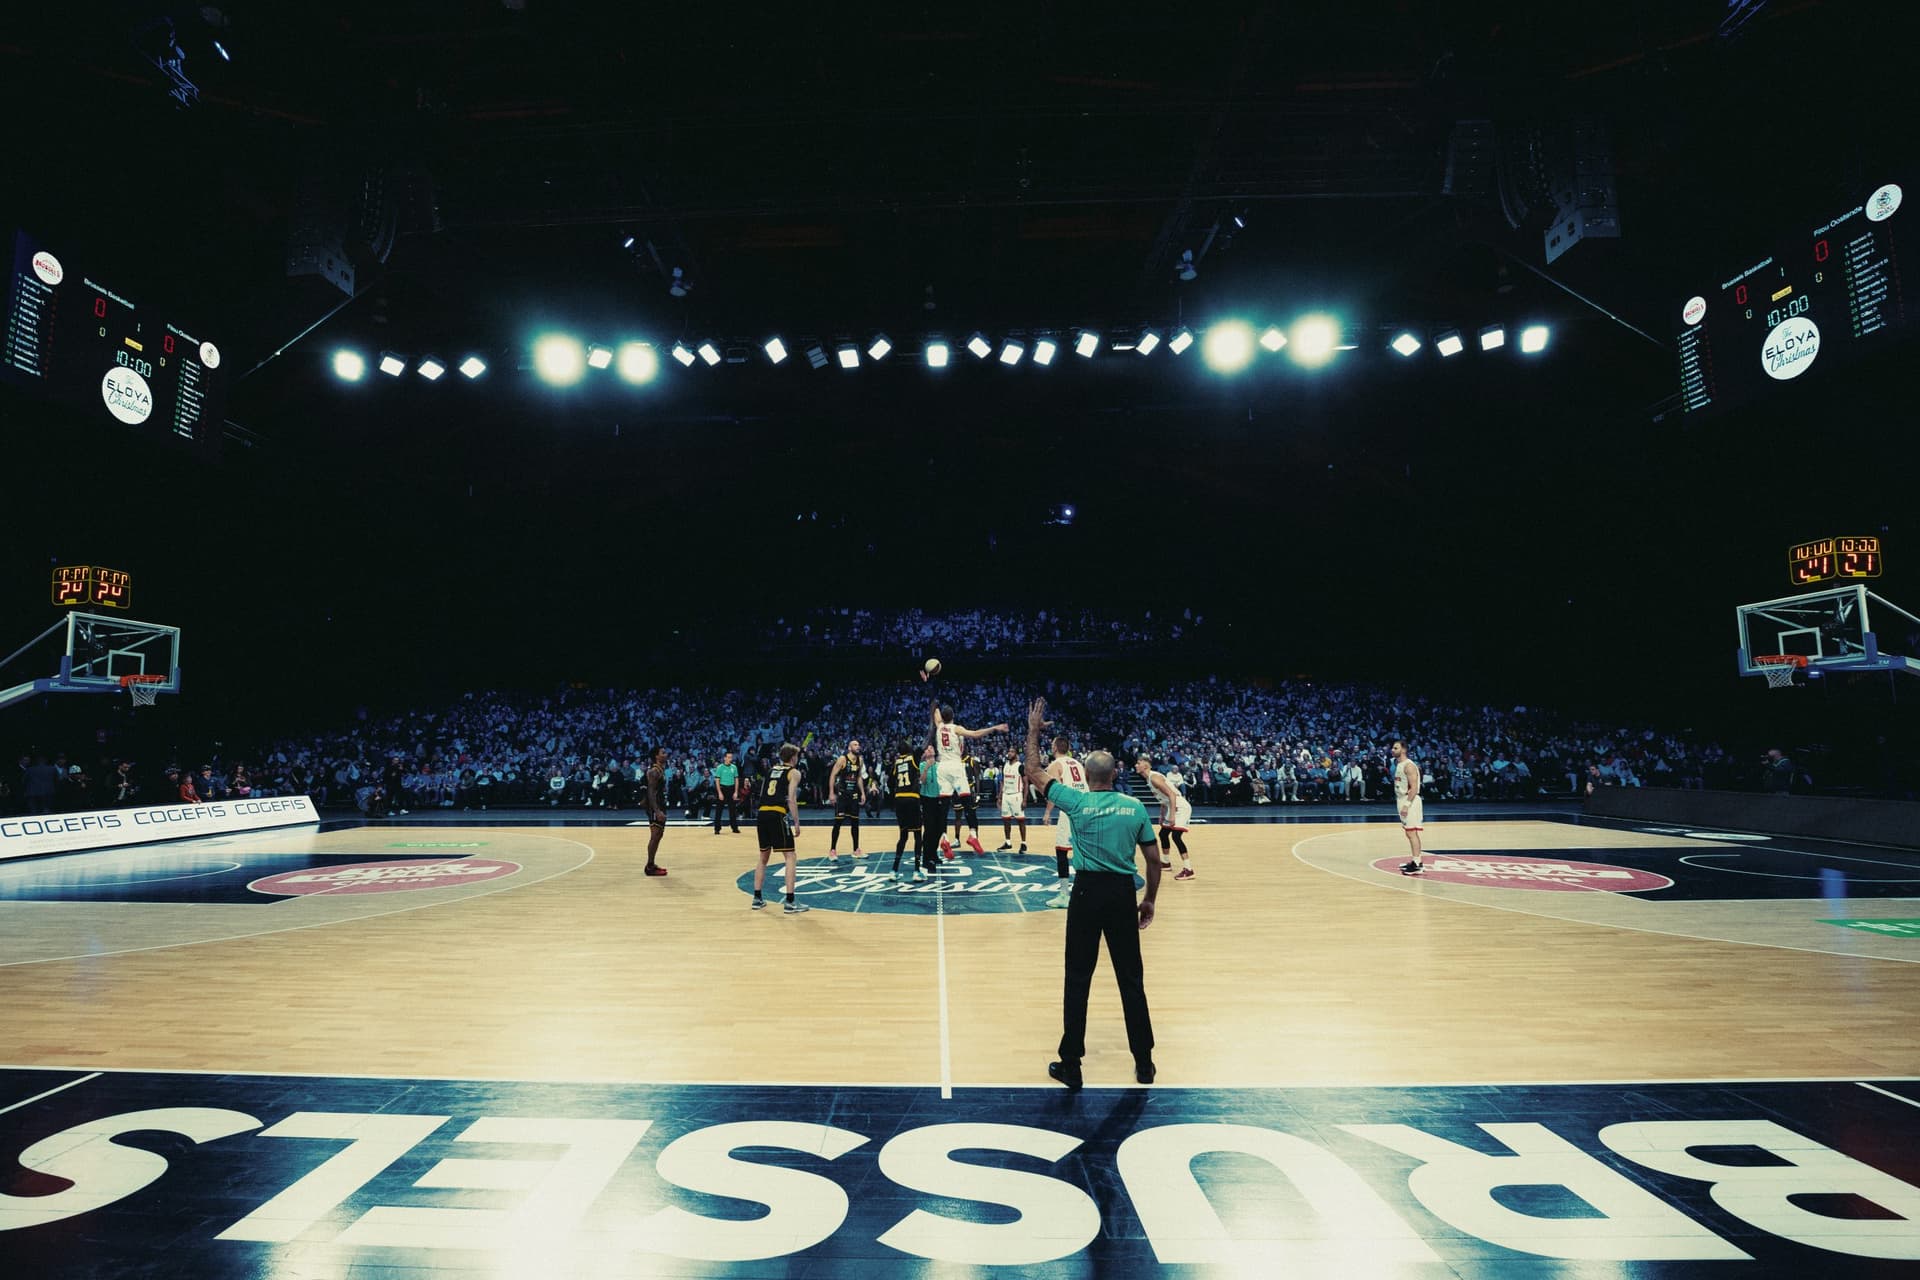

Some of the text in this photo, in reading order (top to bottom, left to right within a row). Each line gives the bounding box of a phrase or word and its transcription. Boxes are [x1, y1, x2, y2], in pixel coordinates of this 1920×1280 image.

[1815, 240, 1829, 262] 0
[1815, 271, 1823, 283] 0
[1736, 284, 1748, 305] 0
[95, 298, 106, 318] 0
[1745, 309, 1753, 319] 0
[1767, 294, 1809, 327] 10:00
[99, 327, 106, 337] 0
[164, 335, 174, 353] 0
[1765, 329, 1816, 360] ELOYA
[116, 350, 152, 378] 10:00
[1771, 344, 1816, 372] Christmas
[107, 379, 149, 405] ELOYA
[1070, 766, 1082, 782] 13
[1, 799, 306, 838] COGEFIS COGEFIS COGEFIS
[0, 1107, 1920, 1266] BRUSSELS
